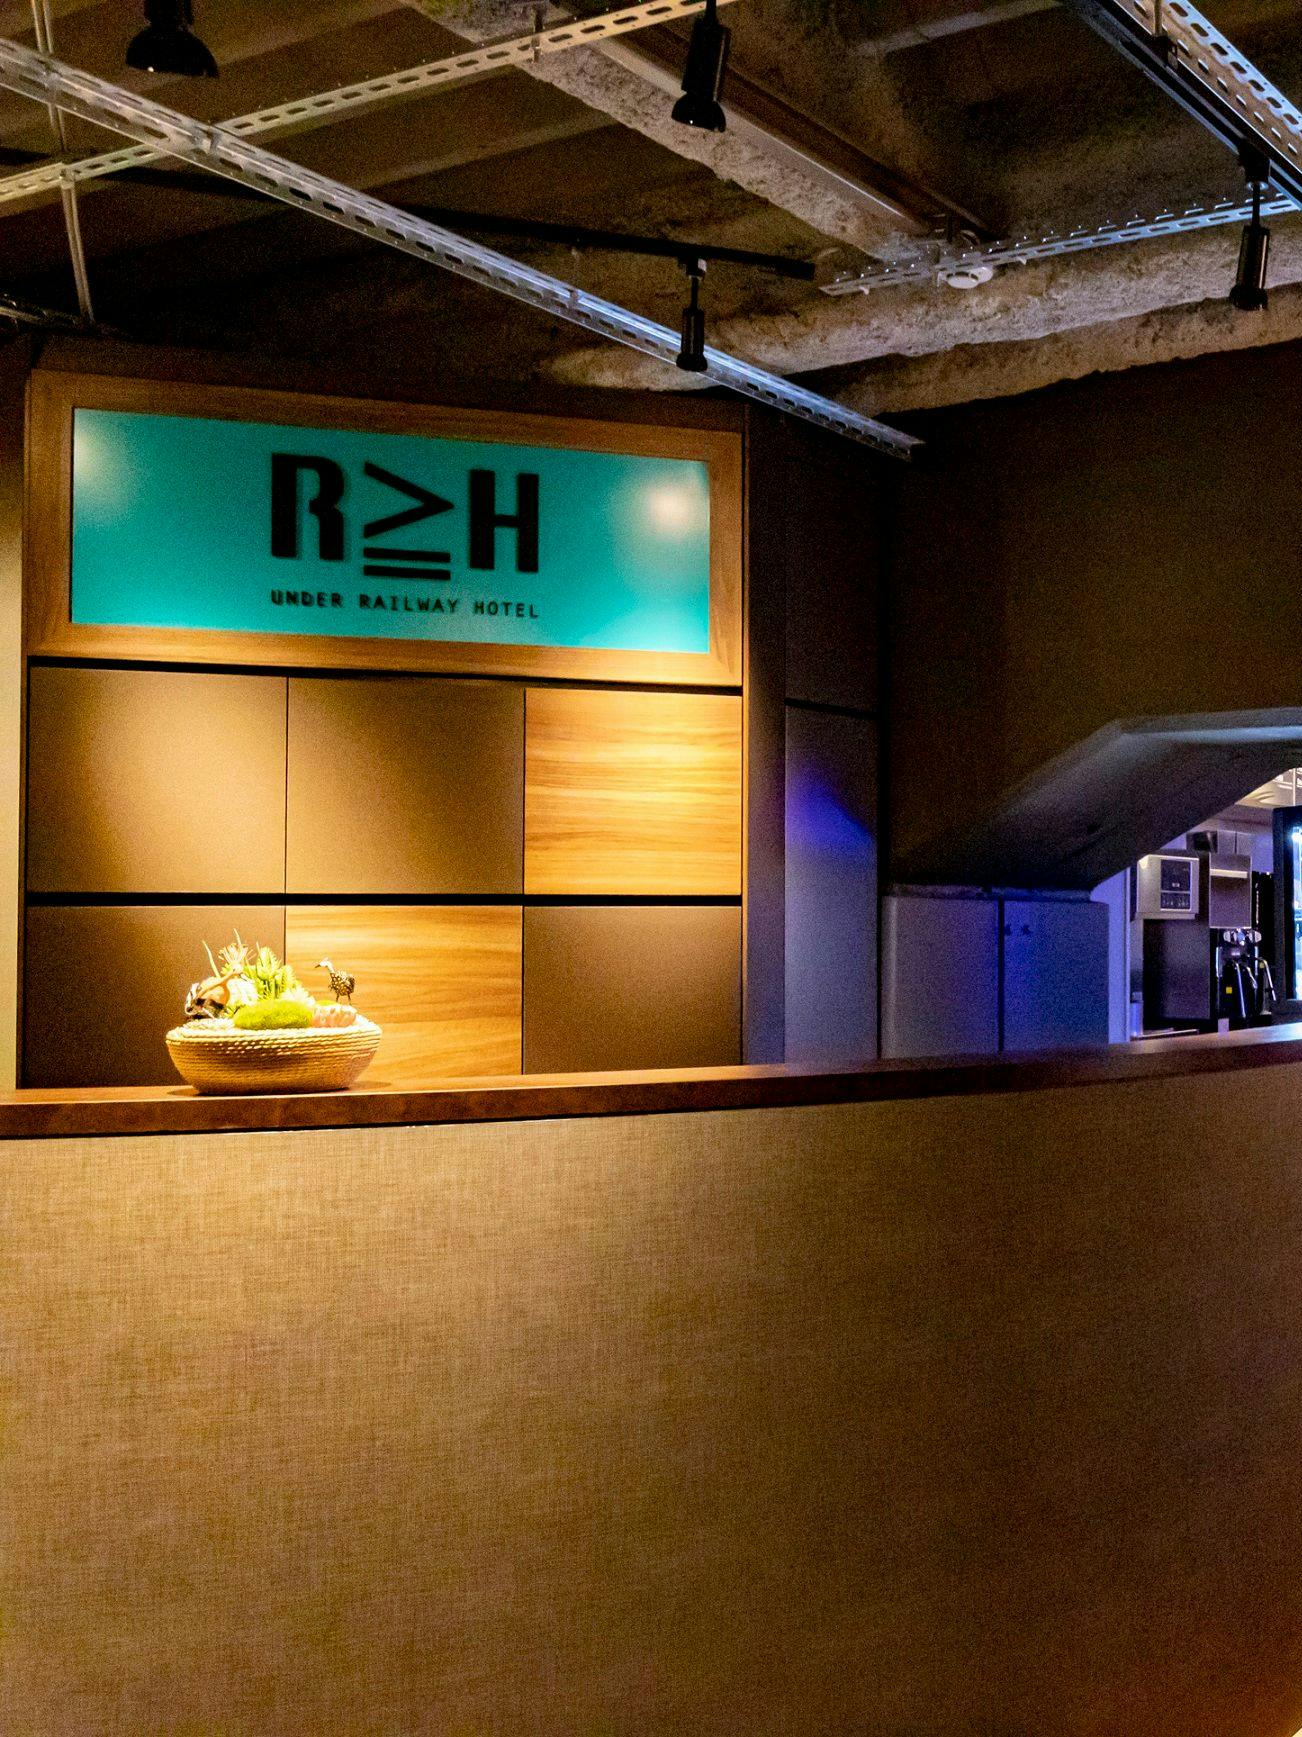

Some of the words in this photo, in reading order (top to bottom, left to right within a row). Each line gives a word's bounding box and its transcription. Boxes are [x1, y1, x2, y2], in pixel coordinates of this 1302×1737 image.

[270, 590, 344, 609] UNDER
[359, 594, 459, 614] RAILWAY
[474, 602, 540, 619] HOTEL
